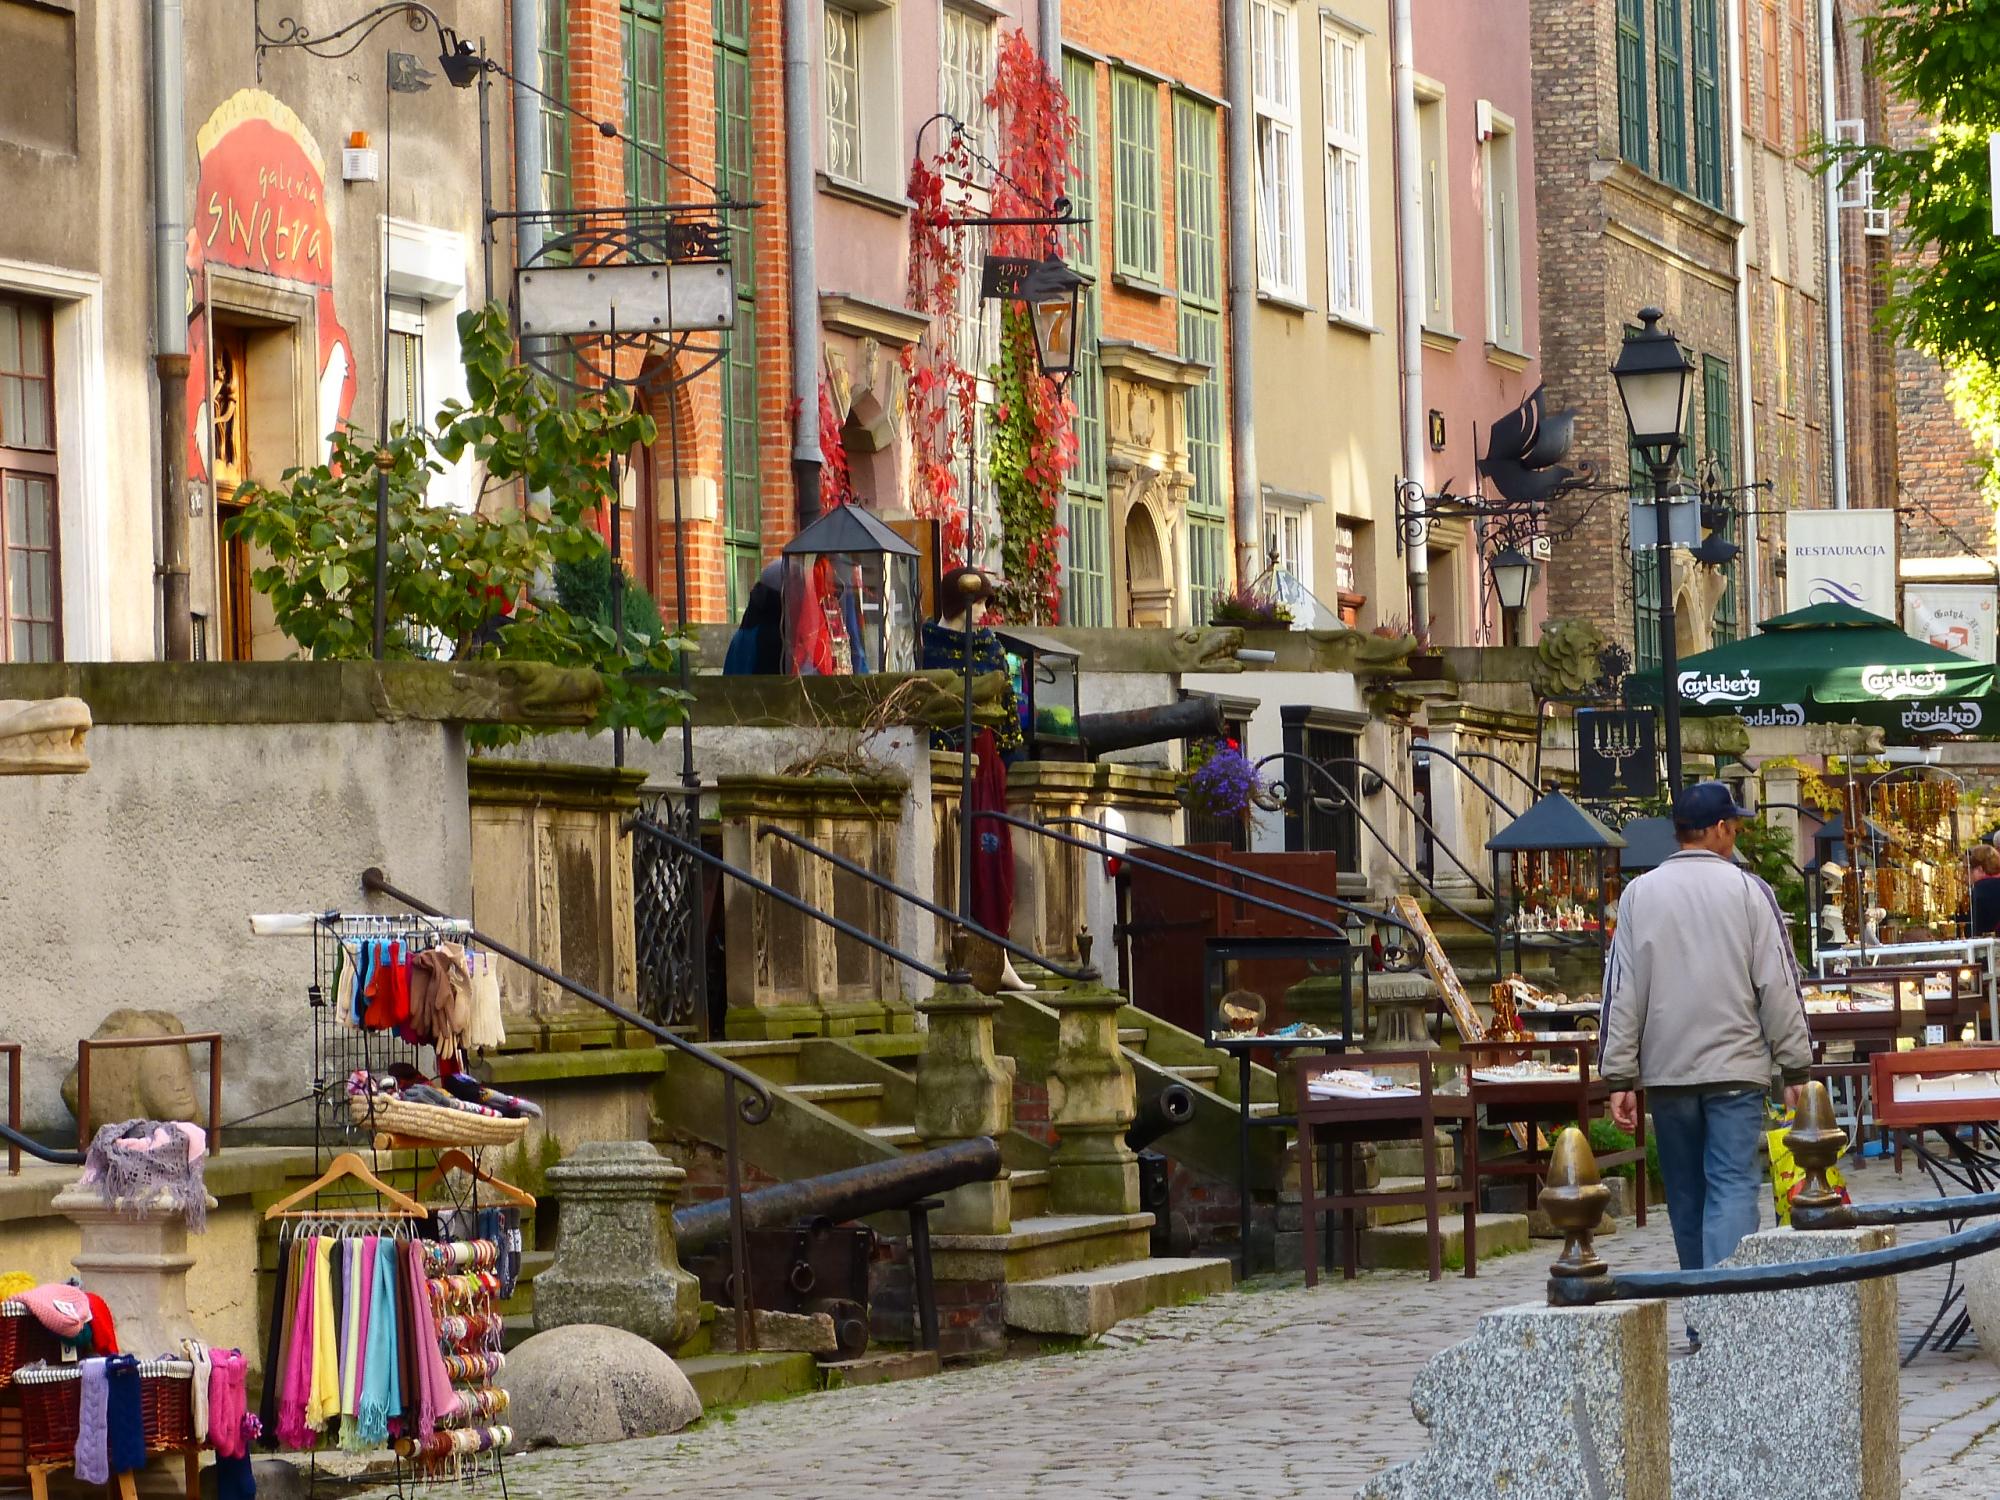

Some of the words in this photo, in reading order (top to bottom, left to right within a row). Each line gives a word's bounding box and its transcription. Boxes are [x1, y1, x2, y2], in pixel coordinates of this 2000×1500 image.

[259, 161, 318, 208] galeria
[1795, 545, 1886, 556] RESTAURACJA
[1678, 669, 1760, 705] Carlsberg
[1862, 665, 1947, 700] Carlsberg
